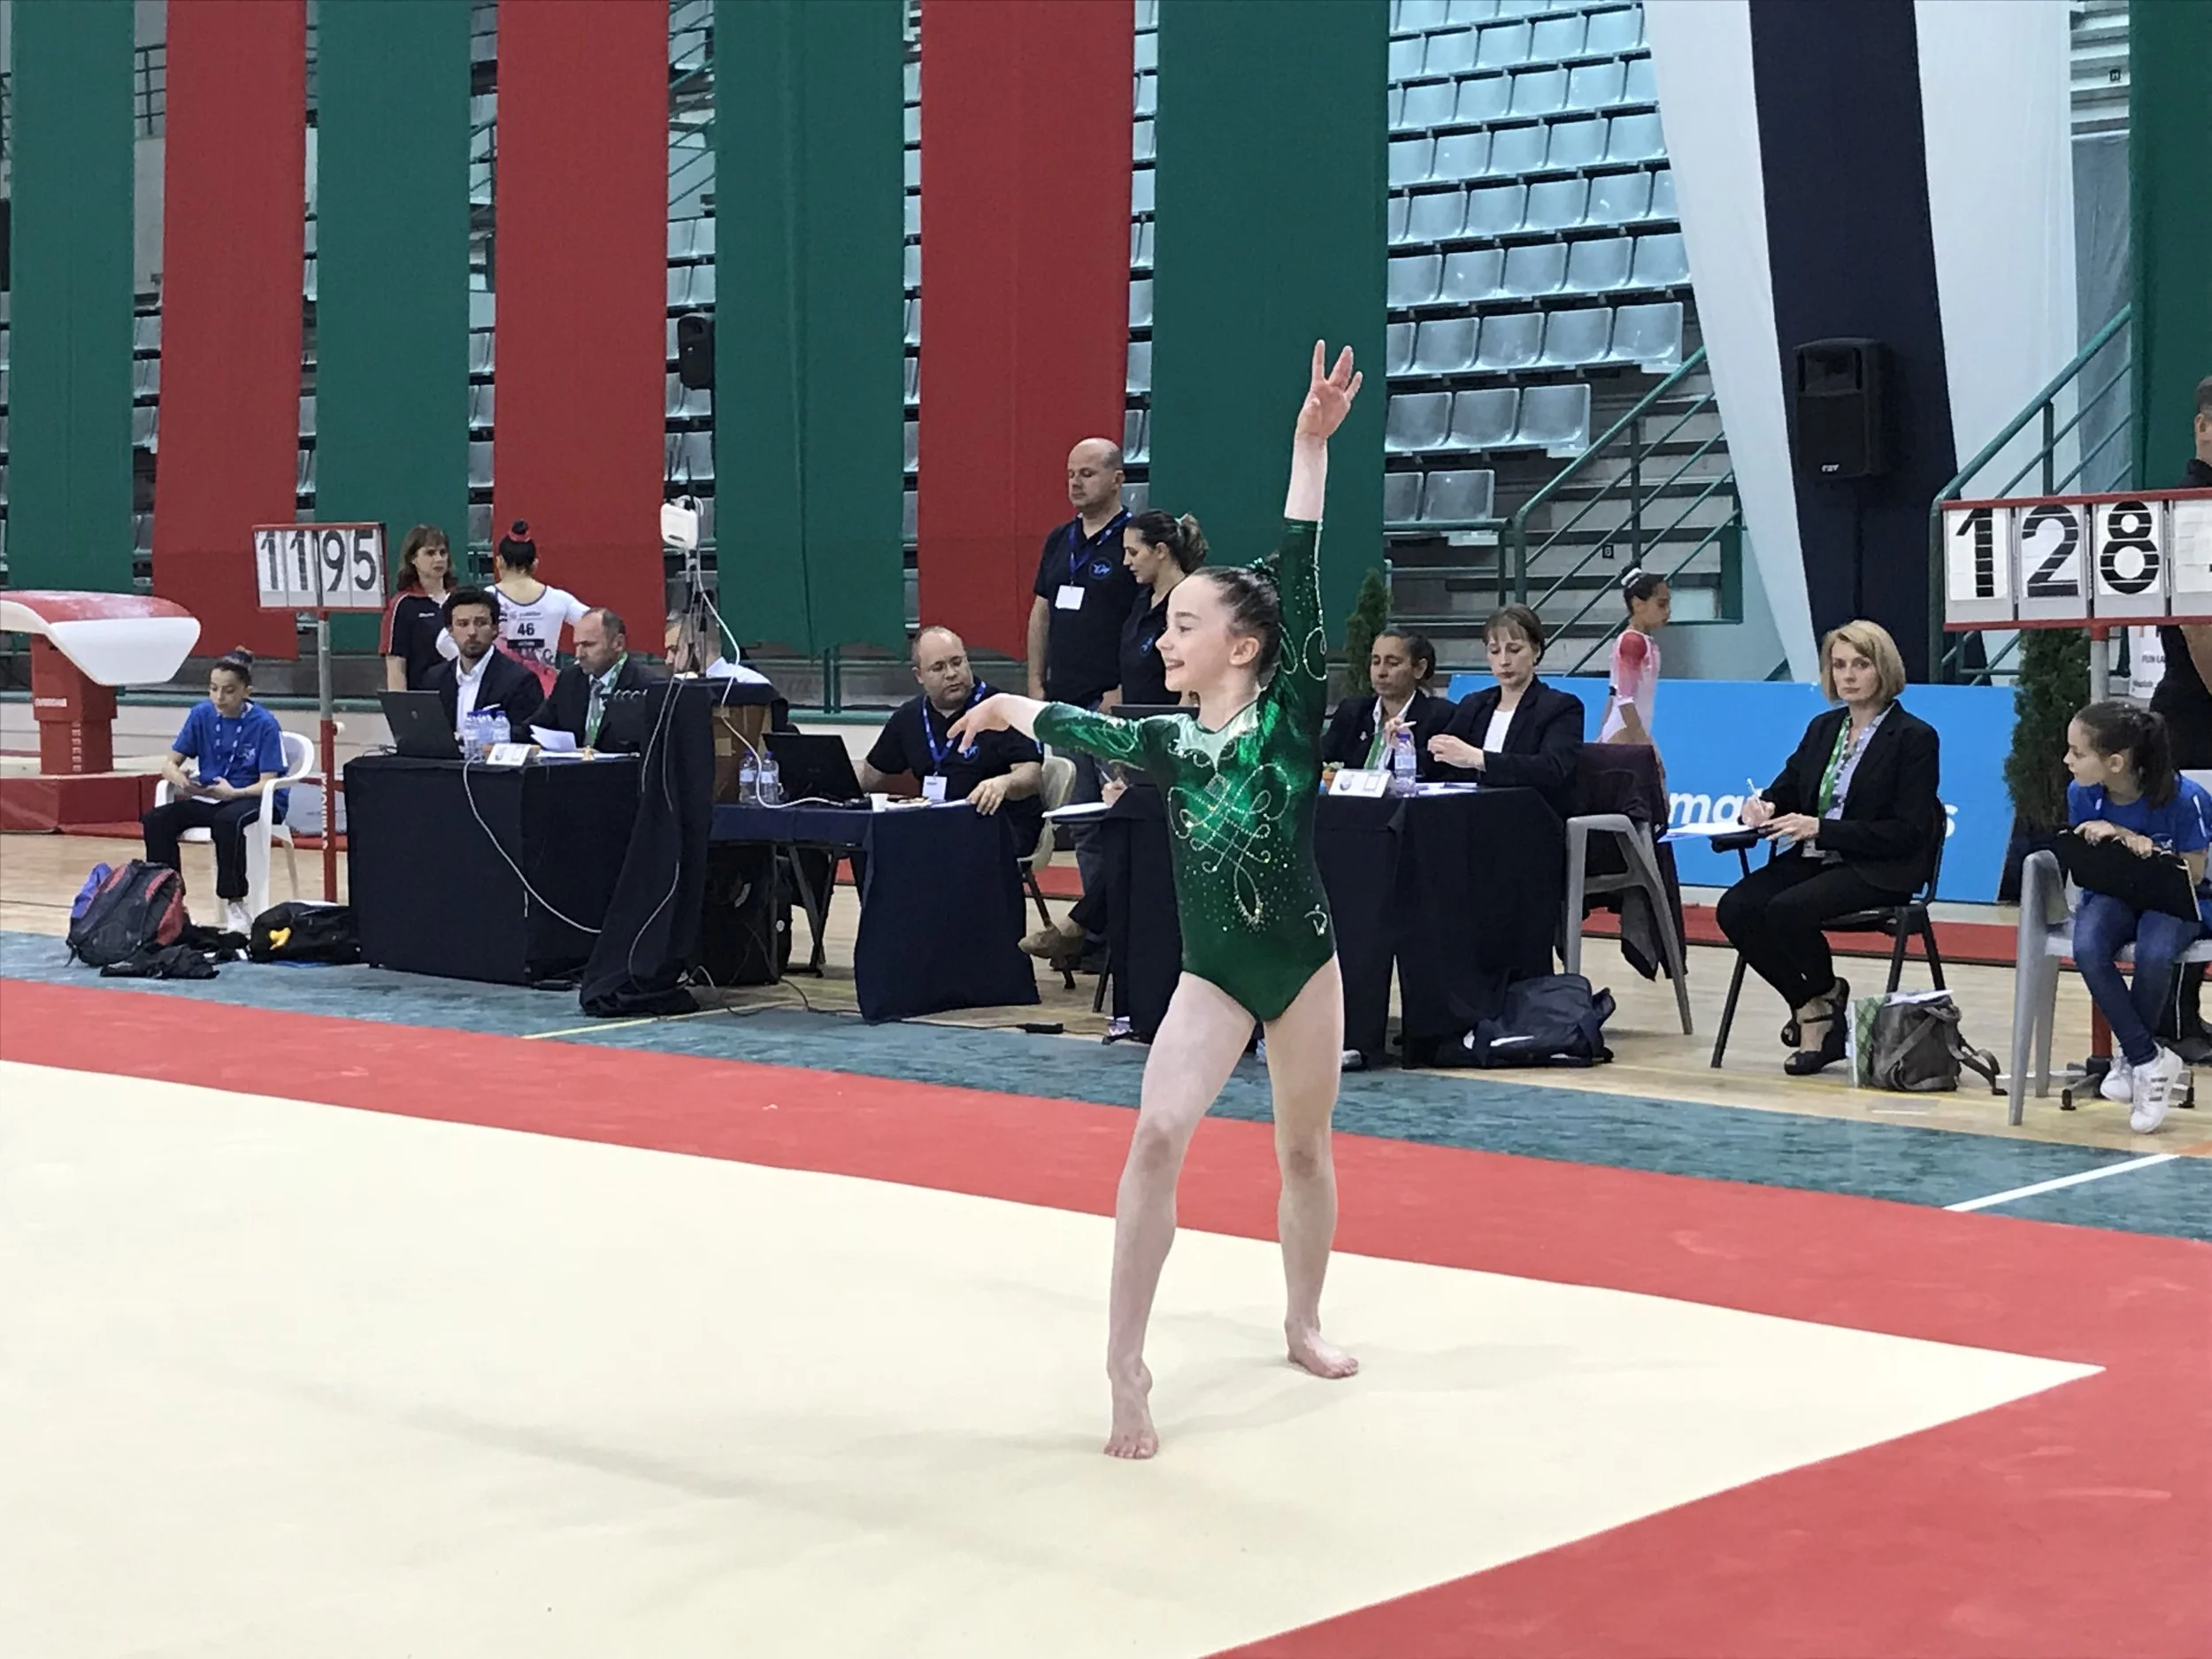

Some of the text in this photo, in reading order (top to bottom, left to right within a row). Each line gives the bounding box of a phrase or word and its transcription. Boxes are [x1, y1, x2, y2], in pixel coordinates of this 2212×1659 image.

[1955, 500, 2212, 598] 128
[518, 623, 535, 636] 46
[1667, 793, 1745, 824] ma
